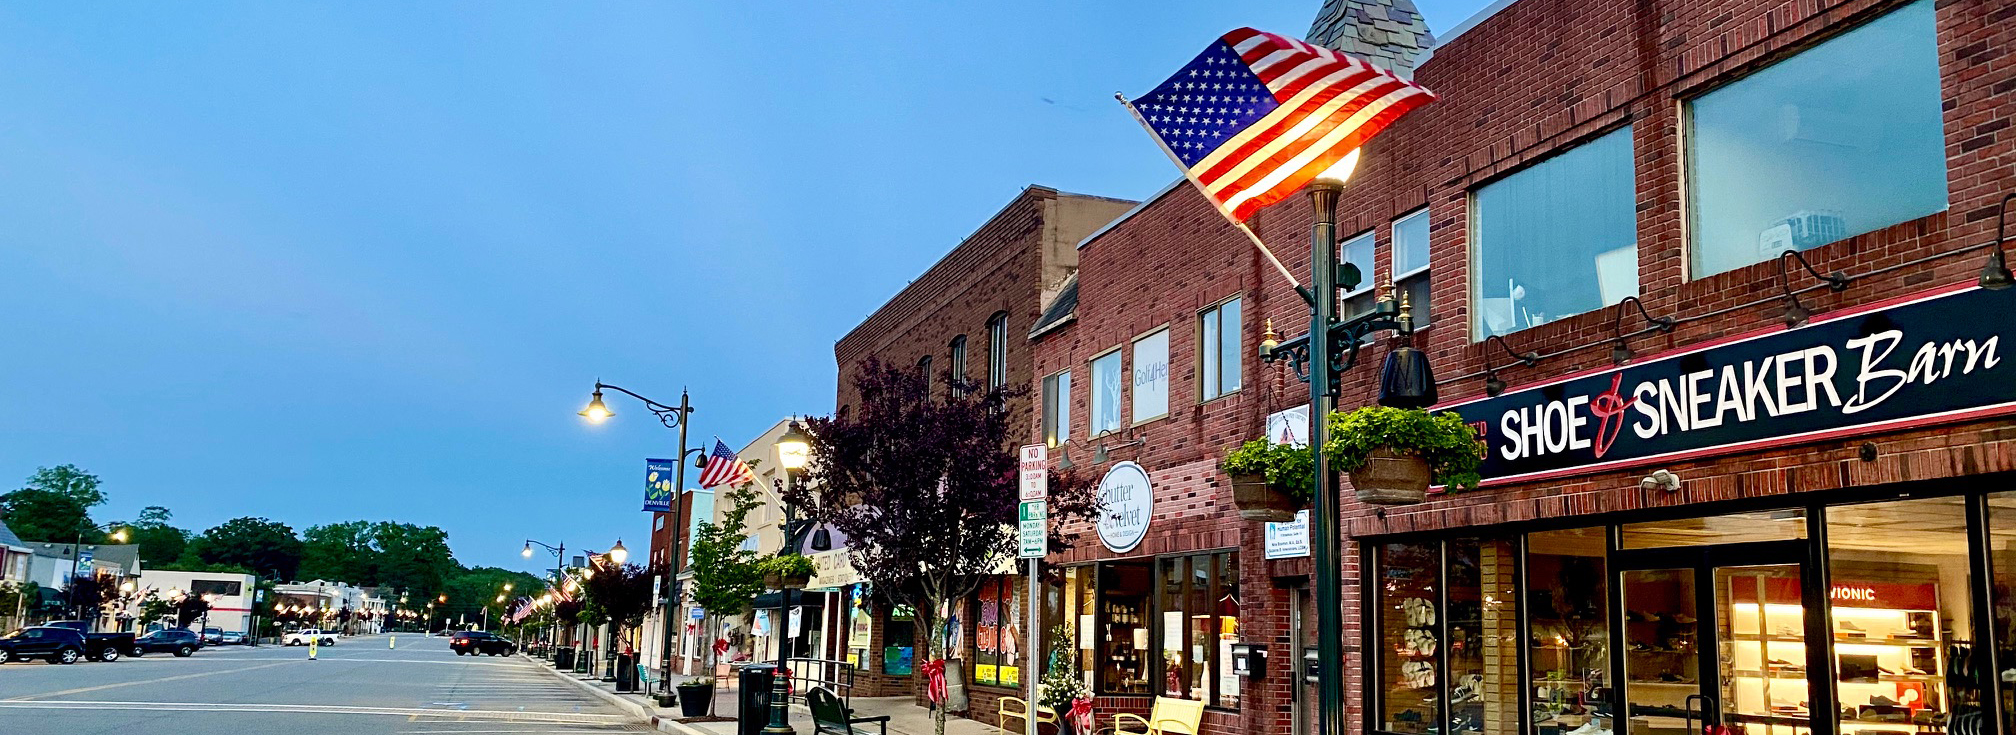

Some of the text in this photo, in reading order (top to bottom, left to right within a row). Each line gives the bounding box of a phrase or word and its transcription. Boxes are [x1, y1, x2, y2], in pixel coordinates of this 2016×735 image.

[1500, 394, 1591, 460] SHOE
[1633, 345, 1842, 439] SNEAKER
[1842, 330, 2000, 414] Barn
[1028, 448, 1038, 458] NO
[1021, 460, 1046, 472] PARKING
[1105, 482, 1134, 504] butter
[1022, 530, 1043, 538] SATURDAY
[1830, 586, 1876, 601] VIONIC
